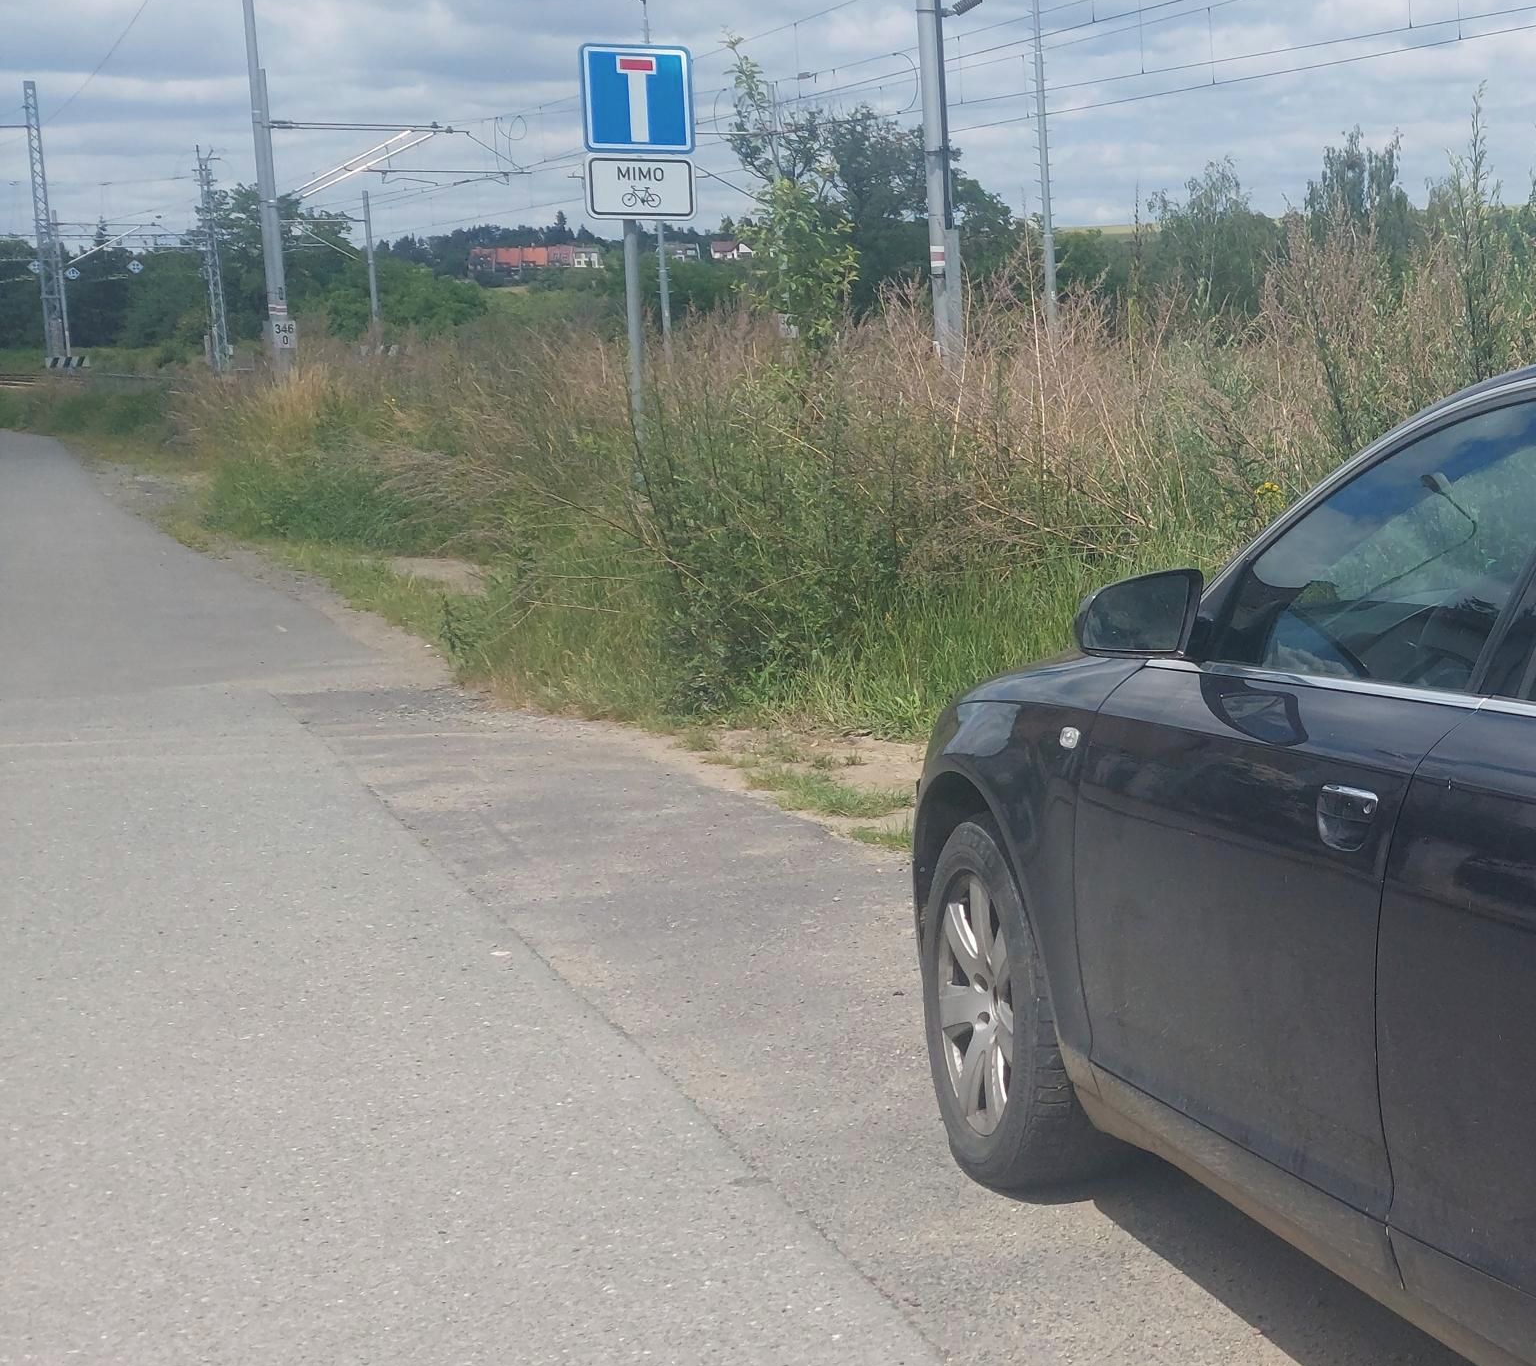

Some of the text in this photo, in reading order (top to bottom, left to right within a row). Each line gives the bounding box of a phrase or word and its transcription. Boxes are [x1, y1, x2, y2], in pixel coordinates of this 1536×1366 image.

[617, 166, 664, 182] MIMO
[275, 323, 294, 334] 346
[282, 335, 289, 345] 0
